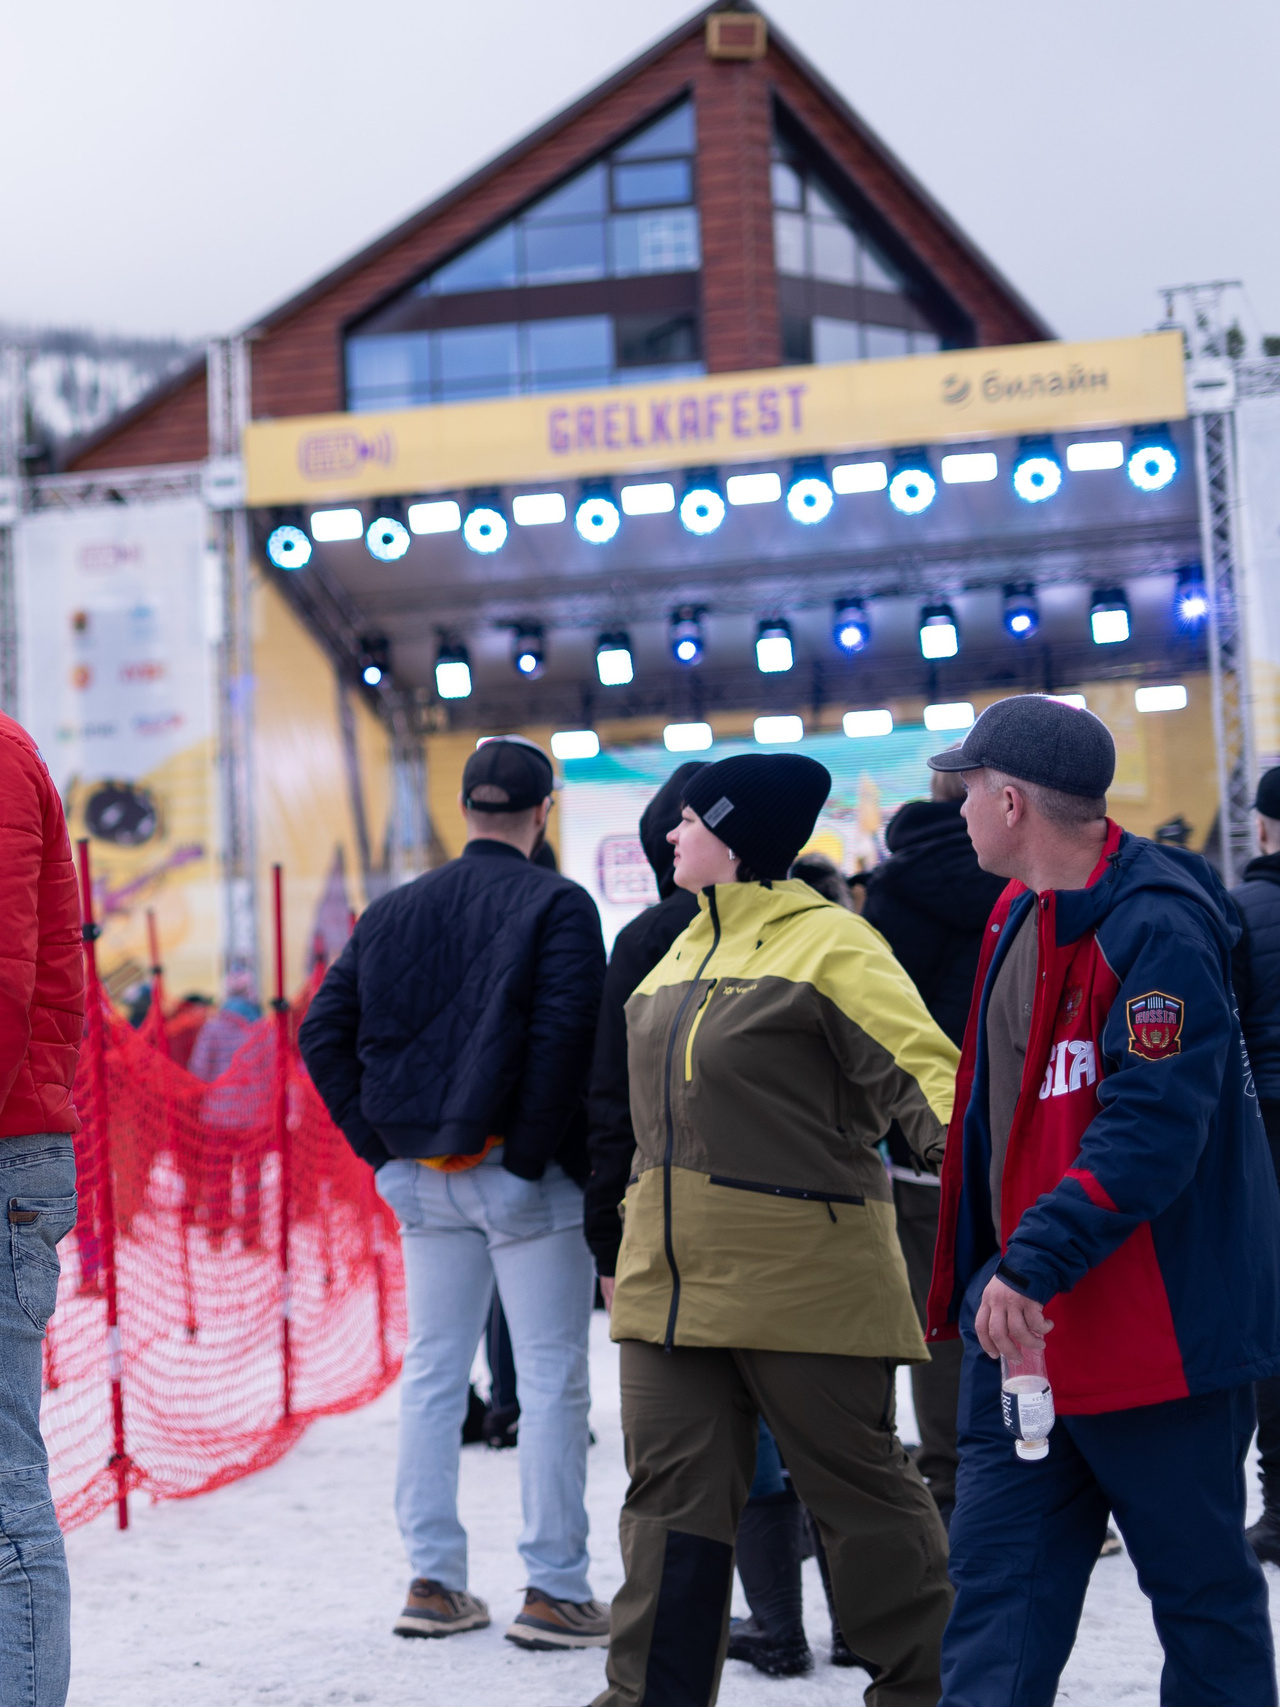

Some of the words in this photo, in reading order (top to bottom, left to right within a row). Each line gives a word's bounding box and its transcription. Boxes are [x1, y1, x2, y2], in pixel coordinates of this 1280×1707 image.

[982, 362, 1109, 402] билайн
[1135, 1009, 1177, 1024] RUSSIA
[1002, 1394, 1013, 1426] Rich
